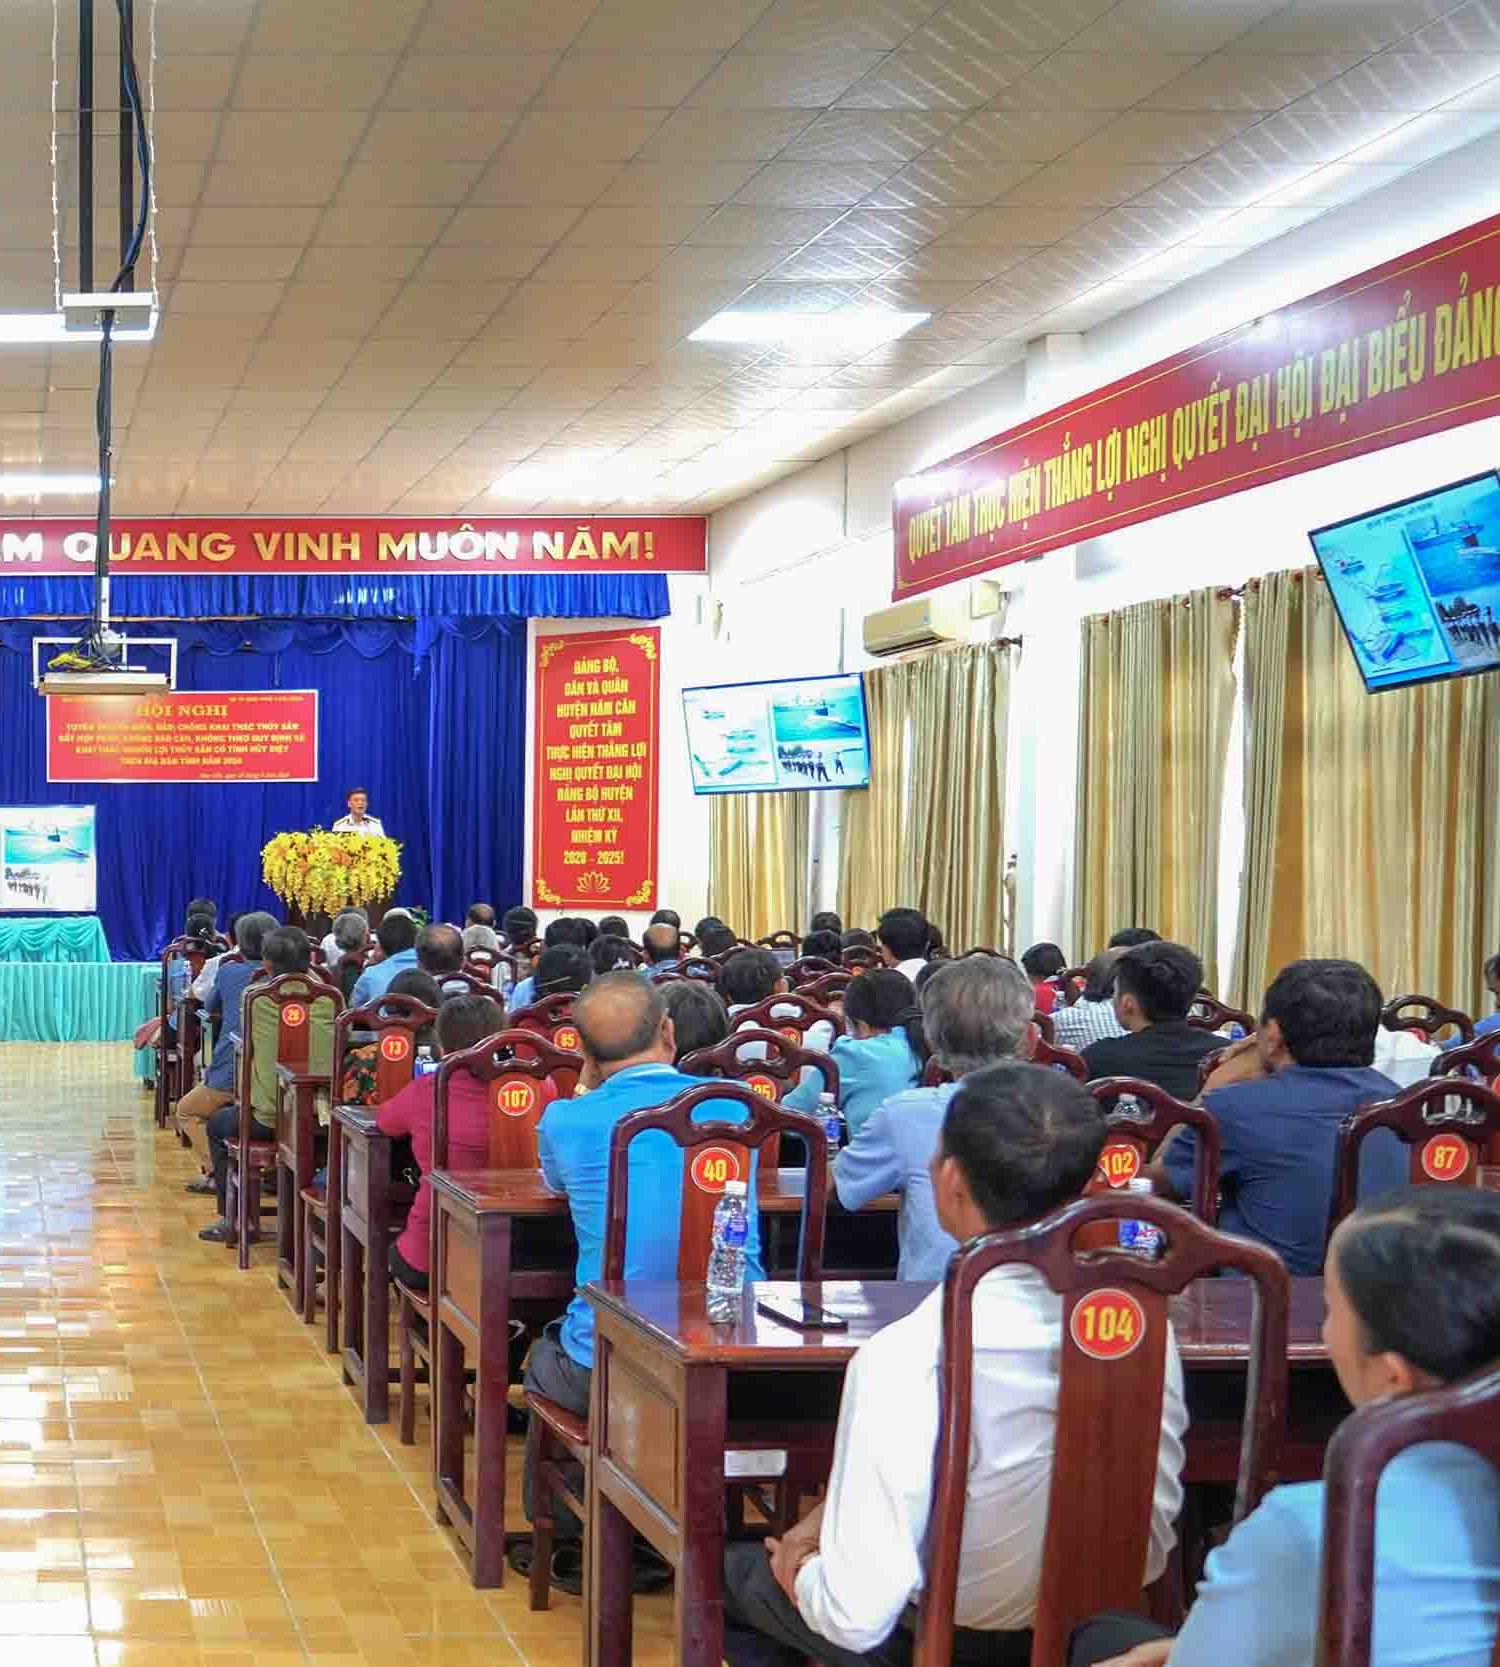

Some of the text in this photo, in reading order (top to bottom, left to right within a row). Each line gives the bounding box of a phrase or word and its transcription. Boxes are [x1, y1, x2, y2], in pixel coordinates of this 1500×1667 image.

[1043, 431, 1093, 511] THẮNG
[1096, 426, 1122, 501] LỢI
[1125, 413, 1167, 482] NGHỊ
[1172, 372, 1232, 471] QUYẾT
[1235, 373, 1269, 451] ĐẠI
[1276, 349, 1315, 438] HỘI
[1320, 337, 1361, 425] ĐẠI
[1367, 289, 1428, 399] BIỂU
[63, 531, 237, 563] QUANG
[252, 531, 360, 562] VINH
[378, 523, 518, 562] MUÔN
[532, 528, 655, 561] NĂM!
[556, 700, 588, 720] HUYỆN
[569, 720, 599, 739] QUYẾT
[601, 784, 633, 805] HUYỆN
[503, 1089, 527, 1108] 107
[1101, 1152, 1133, 1176] 102
[1433, 1147, 1458, 1169] 87
[703, 1160, 727, 1182] 40
[1083, 1307, 1135, 1343] 104
